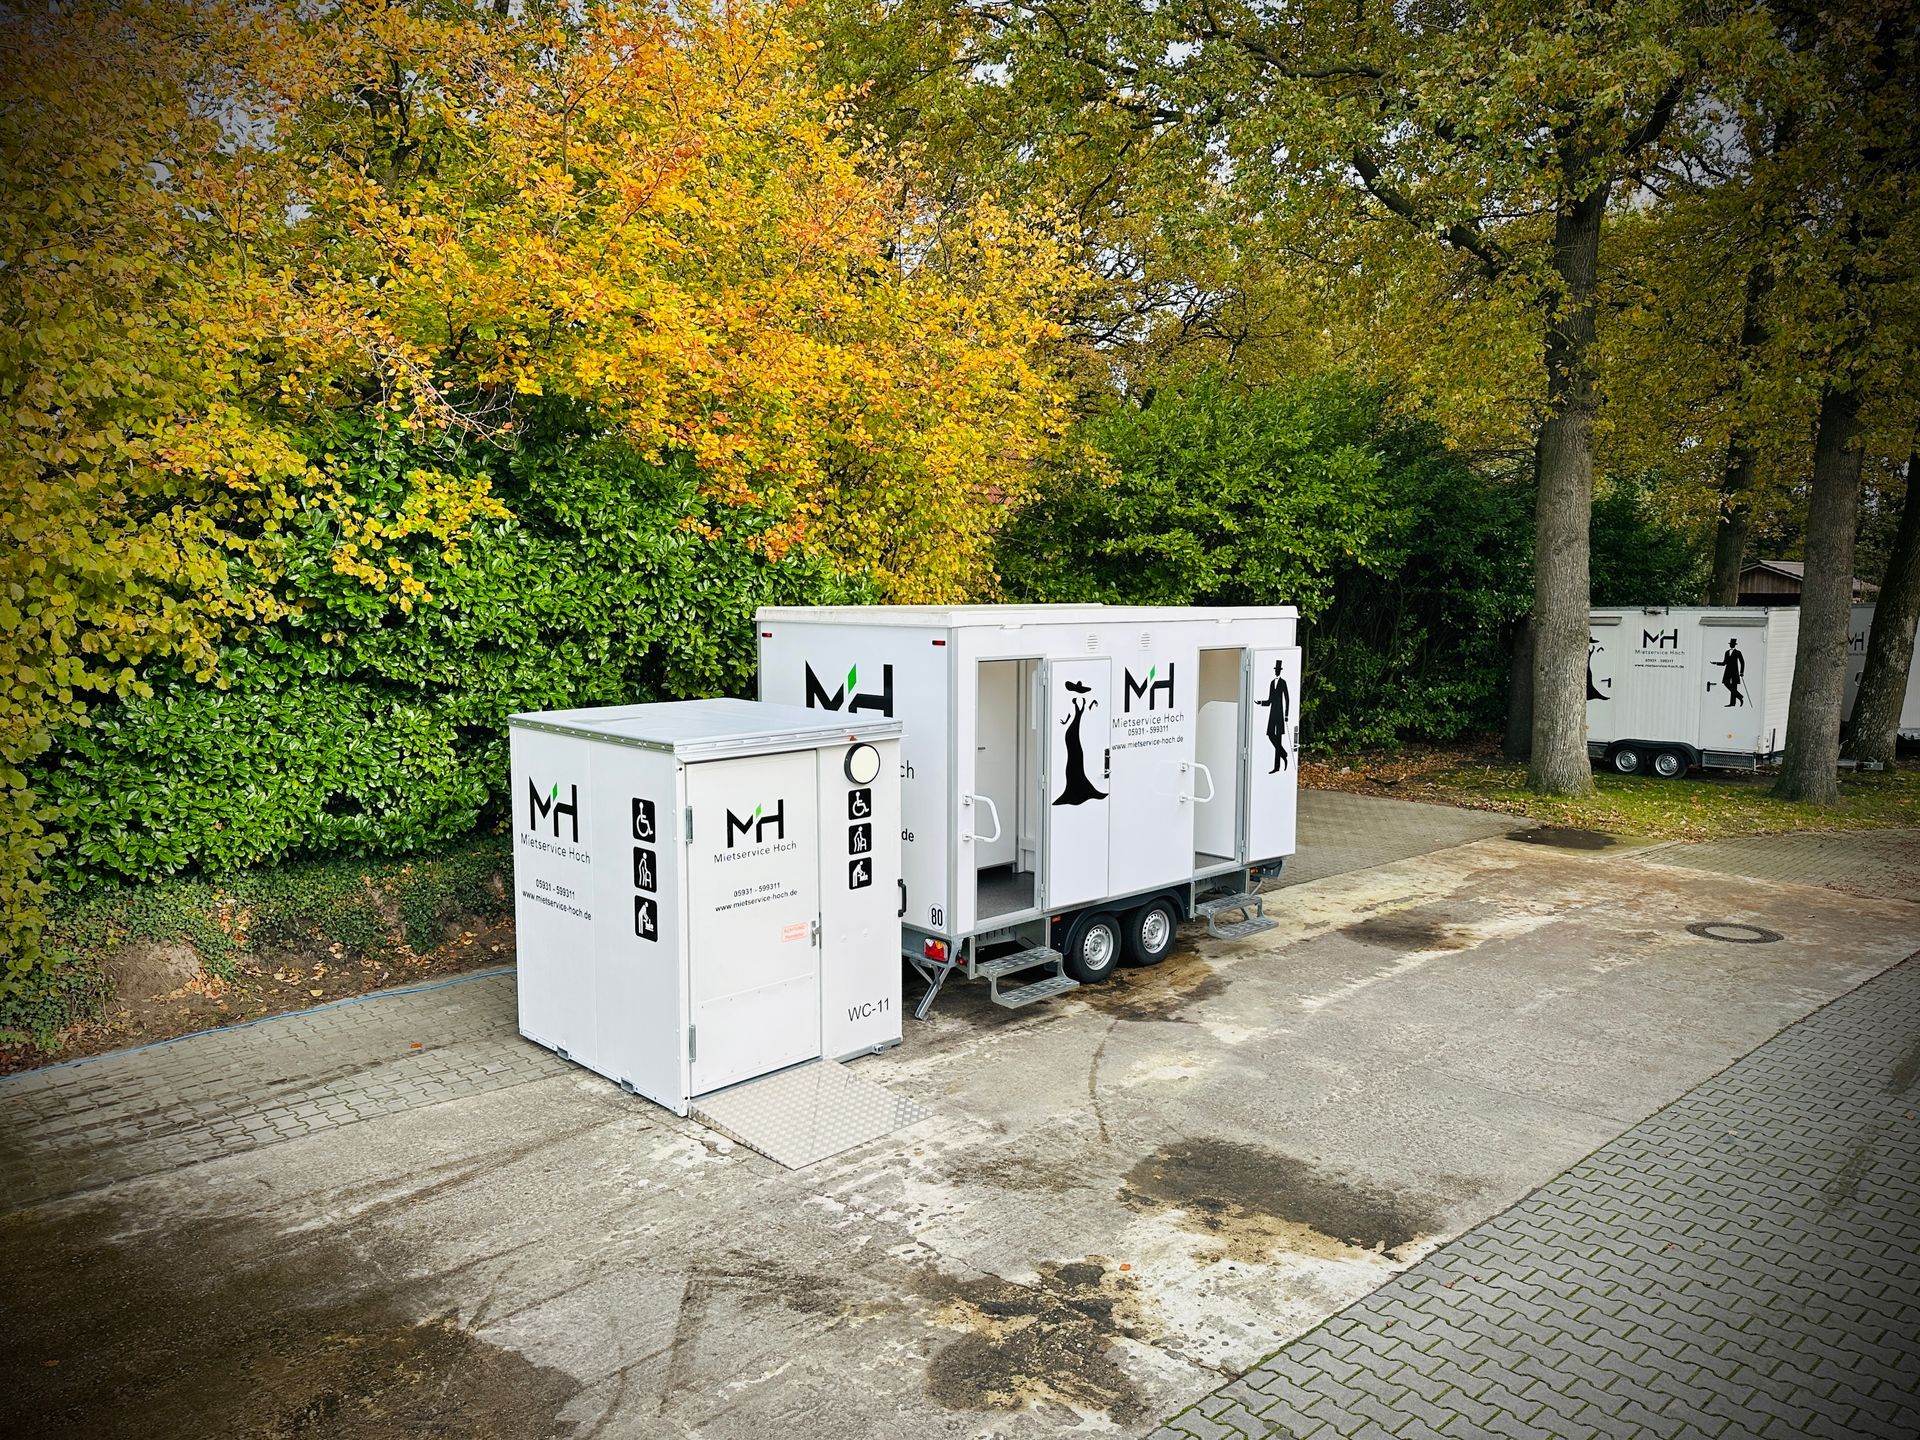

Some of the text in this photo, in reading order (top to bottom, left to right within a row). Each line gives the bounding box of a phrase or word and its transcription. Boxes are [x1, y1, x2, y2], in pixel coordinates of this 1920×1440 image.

[1643, 629, 1678, 649] MH
[1124, 663, 1174, 713] MH
[1112, 712, 1184, 729] Mietservice Hoch
[1127, 727, 1145, 736] 05931
[1150, 725, 1169, 734] 599311
[1112, 736, 1184, 750] www.mietservice-hoch.de
[529, 776, 578, 843] MH
[726, 799, 784, 848] MH
[520, 833, 591, 865] Mietservice Hoch
[714, 841, 797, 863] Mietservice Hoch
[535, 878, 552, 891] 05931
[556, 885, 575, 900] 599311
[733, 888, 753, 898] 05931
[758, 882, 780, 893] 599311
[522, 890, 591, 920] www.mietservice-hoch.de
[715, 889, 798, 912] www.mietservice-hoch.de
[931, 907, 943, 926] 80
[848, 998, 889, 1021] WC-11
